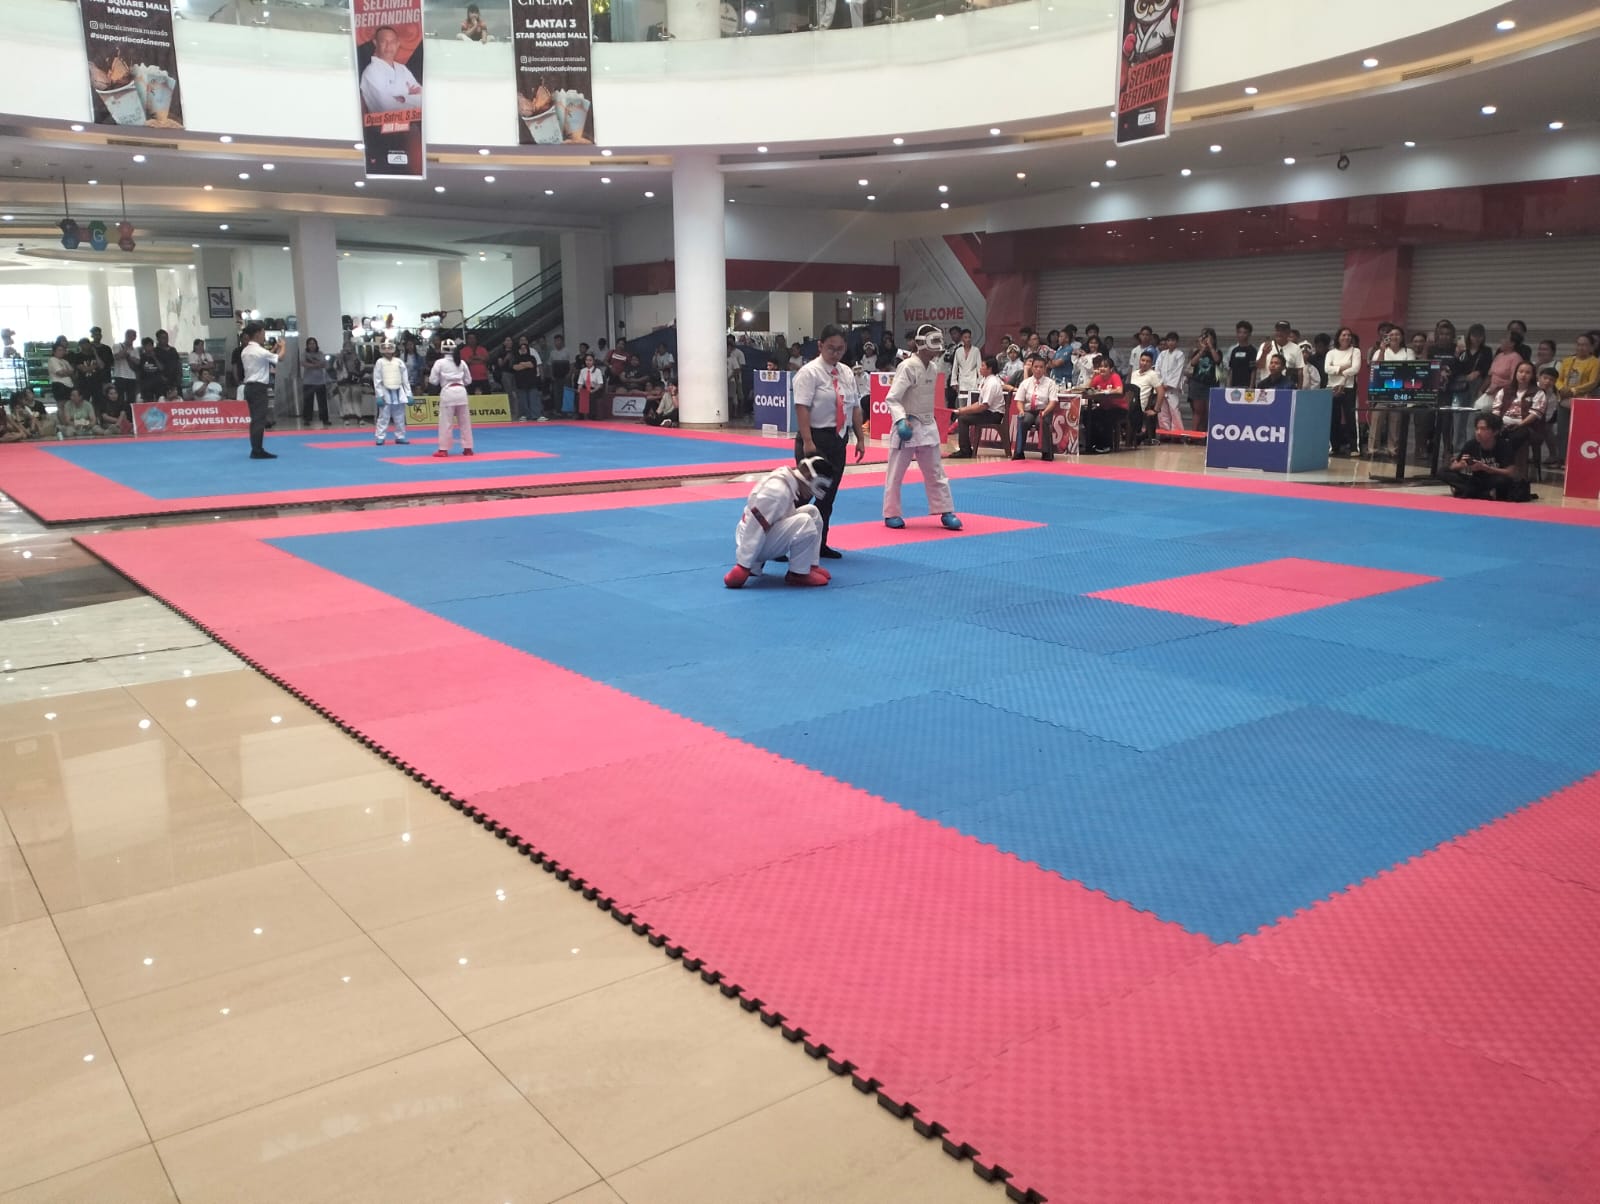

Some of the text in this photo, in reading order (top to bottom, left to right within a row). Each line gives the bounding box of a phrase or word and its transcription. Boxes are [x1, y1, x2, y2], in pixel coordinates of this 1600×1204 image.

[145, 2, 169, 12] MALL
[363, 0, 413, 11] SELAMAT
[107, 6, 148, 18] MANADO
[354, 8, 421, 27] BERTANDING
[525, 19, 577, 28] LANTAI 3
[90, 32, 170, 47] #supportlocalcinema
[536, 32, 566, 40] SQUARE
[903, 306, 964, 321] WELCOME
[754, 394, 785, 408] COACH
[171, 407, 219, 416] PROVINSI
[479, 408, 507, 416] UTARA
[172, 416, 225, 426] SULAWESI
[1211, 423, 1286, 443] COACH
